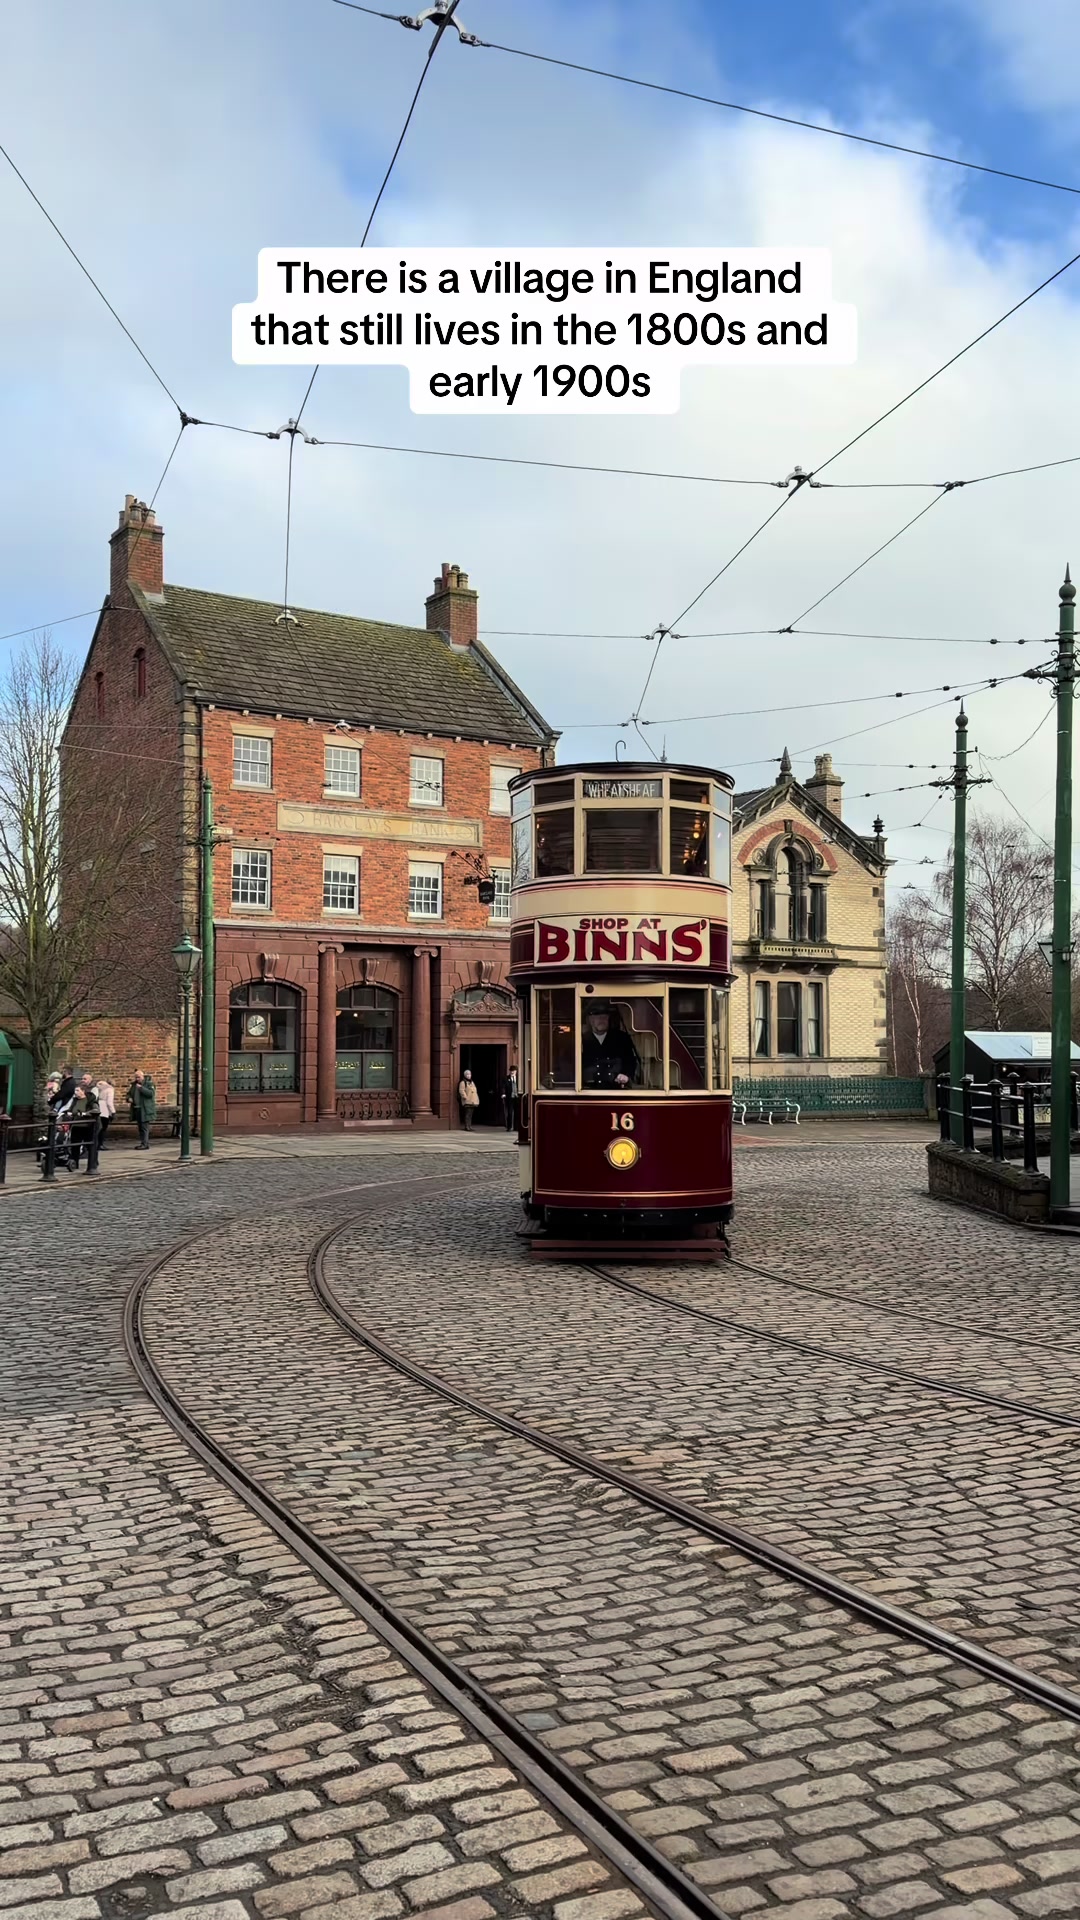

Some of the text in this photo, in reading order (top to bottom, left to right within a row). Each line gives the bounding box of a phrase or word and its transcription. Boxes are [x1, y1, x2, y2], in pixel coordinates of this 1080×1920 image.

[588, 783, 656, 798] WHEATSHEAF
[312, 812, 449, 838] BARCLAYS BANK
[579, 918, 661, 930] SHOP AT
[610, 1112, 635, 1131] 16
